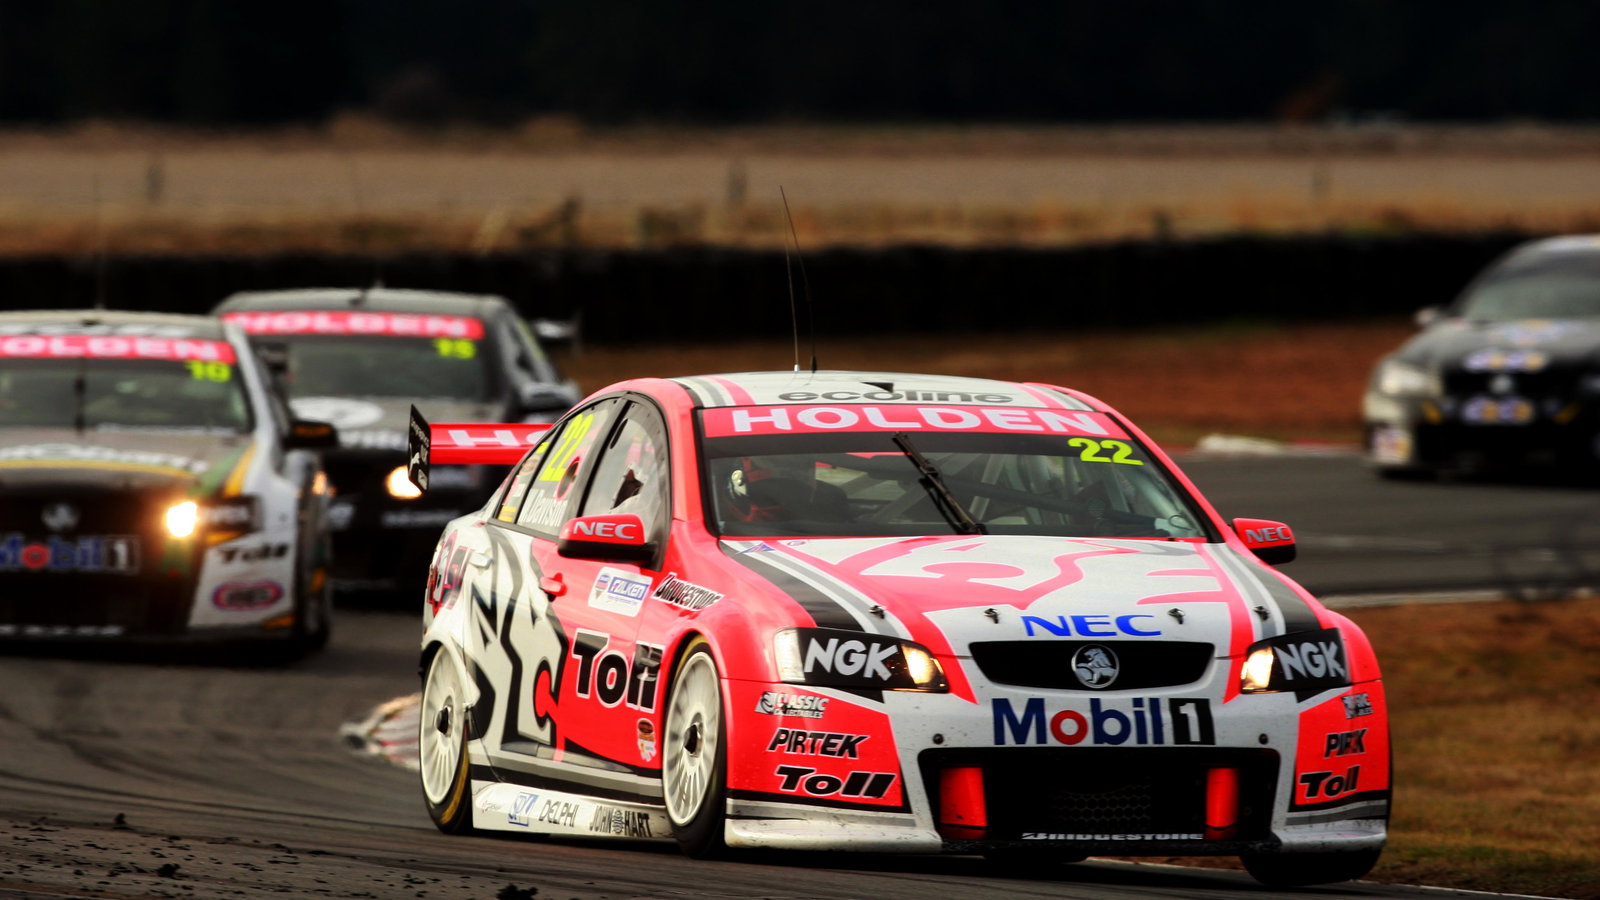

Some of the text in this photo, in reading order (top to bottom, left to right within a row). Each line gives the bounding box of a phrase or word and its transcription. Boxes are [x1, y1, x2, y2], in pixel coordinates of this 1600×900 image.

[0, 336, 221, 361] OLDEN
[777, 389, 1015, 404] ecoline
[731, 406, 1110, 436] HOLDEN
[539, 413, 595, 482] 22
[1067, 437, 1145, 467] 22
[572, 521, 638, 540] NEC
[1245, 525, 1293, 544] NEC
[610, 579, 647, 599] FALKEN
[655, 573, 723, 610] BRIDGESTONE
[1020, 613, 1162, 637] NEC
[573, 627, 665, 714] Toll
[802, 636, 900, 682] NGK
[1272, 640, 1346, 682] NGK
[772, 693, 830, 711] CLASSIC
[991, 697, 1165, 746] Mobil
[767, 728, 869, 759] PIRTEK
[775, 765, 897, 799] Toll
[1299, 765, 1361, 799] Toll
[538, 799, 580, 828] DELPHI
[589, 804, 652, 838] JOHN HART
